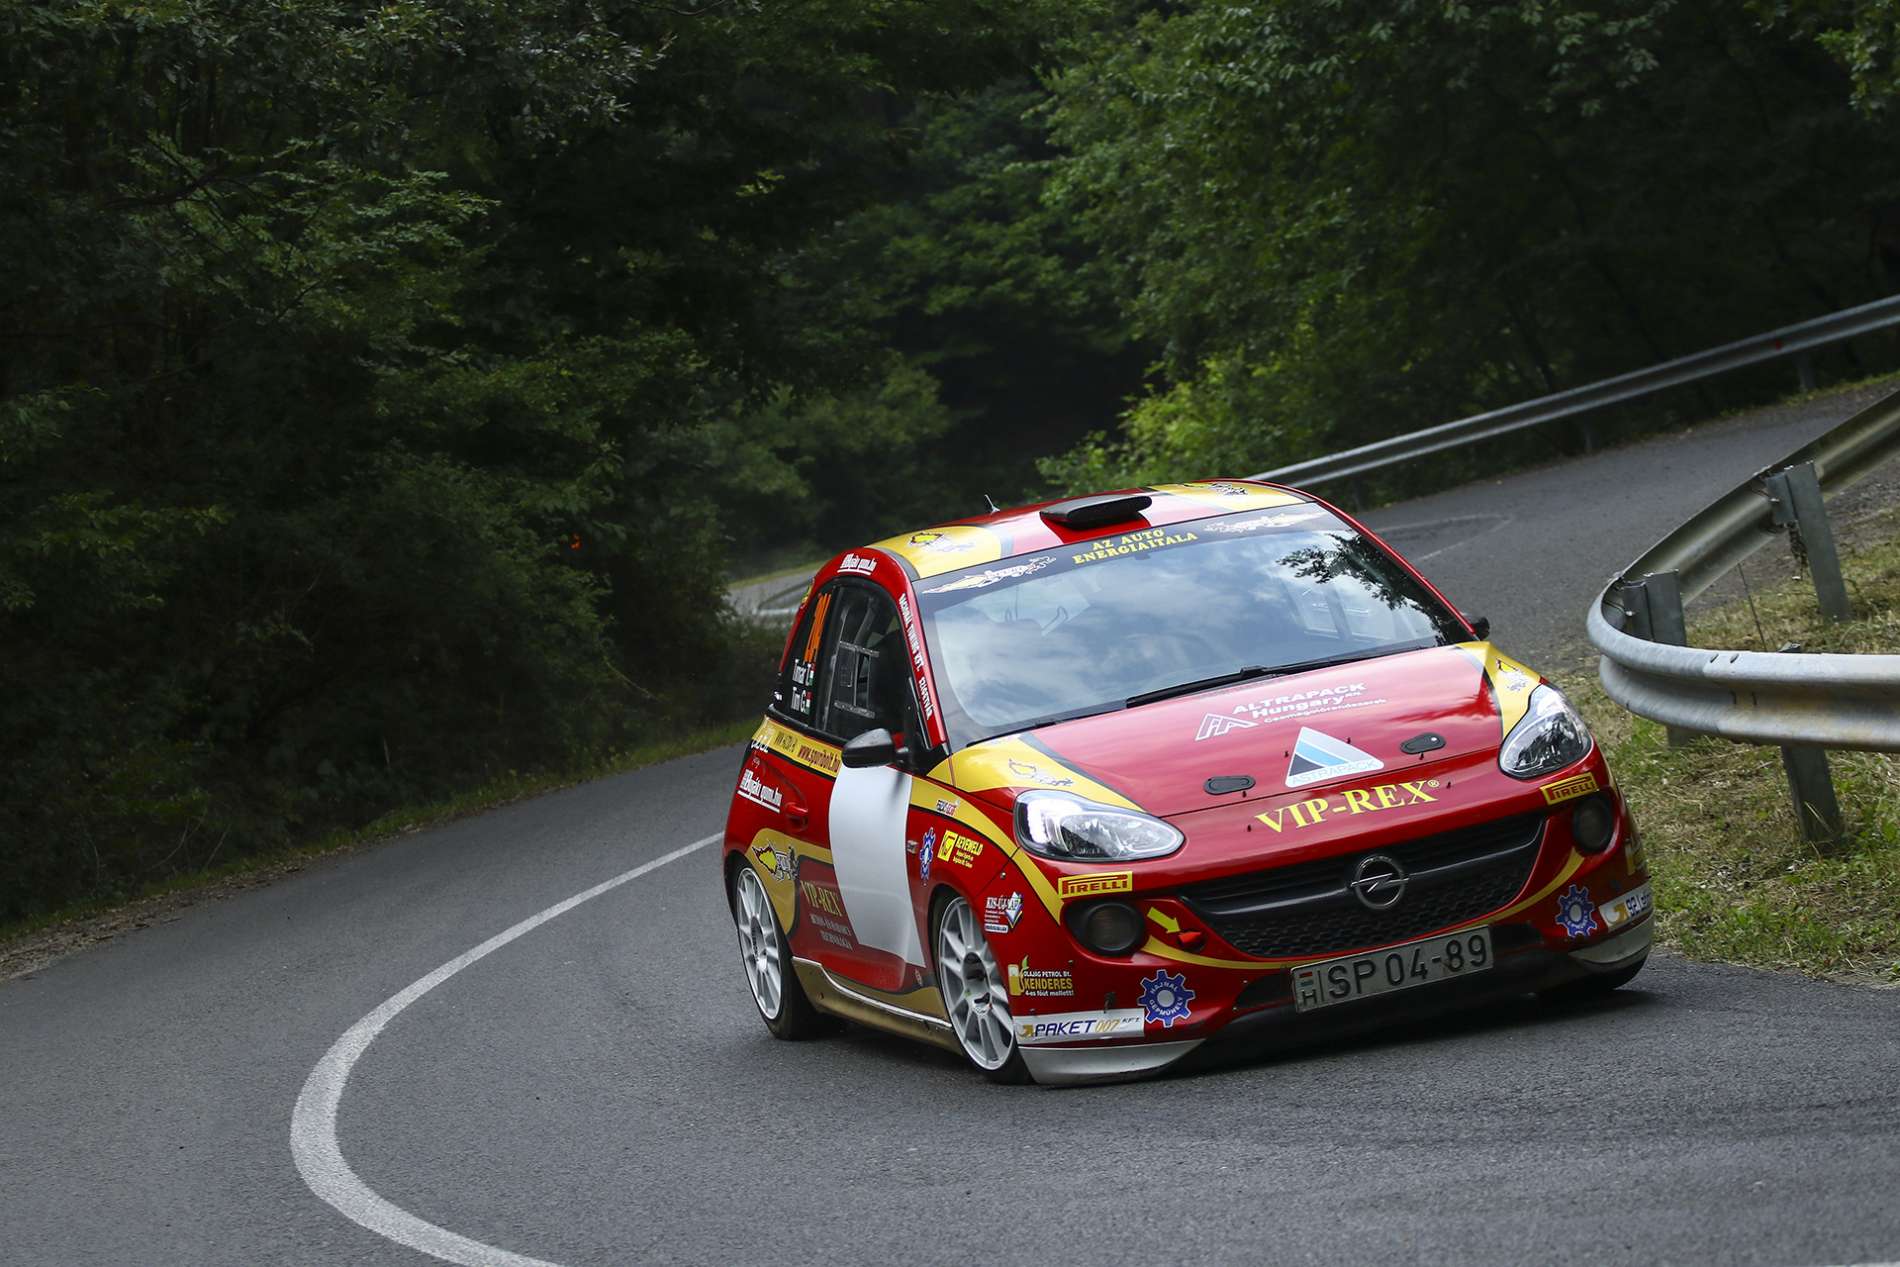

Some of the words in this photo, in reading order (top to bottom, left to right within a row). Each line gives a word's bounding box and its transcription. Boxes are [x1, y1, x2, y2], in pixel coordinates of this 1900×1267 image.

[1072, 531, 1198, 565] ENERGIAITALA
[1092, 539, 1115, 551] AZ
[1232, 682, 1367, 715] ALTRAPACK
[1251, 695, 1345, 719] Hungary
[1292, 758, 1380, 785] ASTRAPACK
[1546, 775, 1597, 801] PIRELLI
[1062, 874, 1128, 895] PIRELLI
[1327, 958, 1376, 998] SP
[1384, 934, 1487, 986] 04-89
[1023, 977, 1073, 990] KENDERES
[1034, 1019, 1097, 1037] PAKET
[1095, 1020, 1121, 1033] 007
